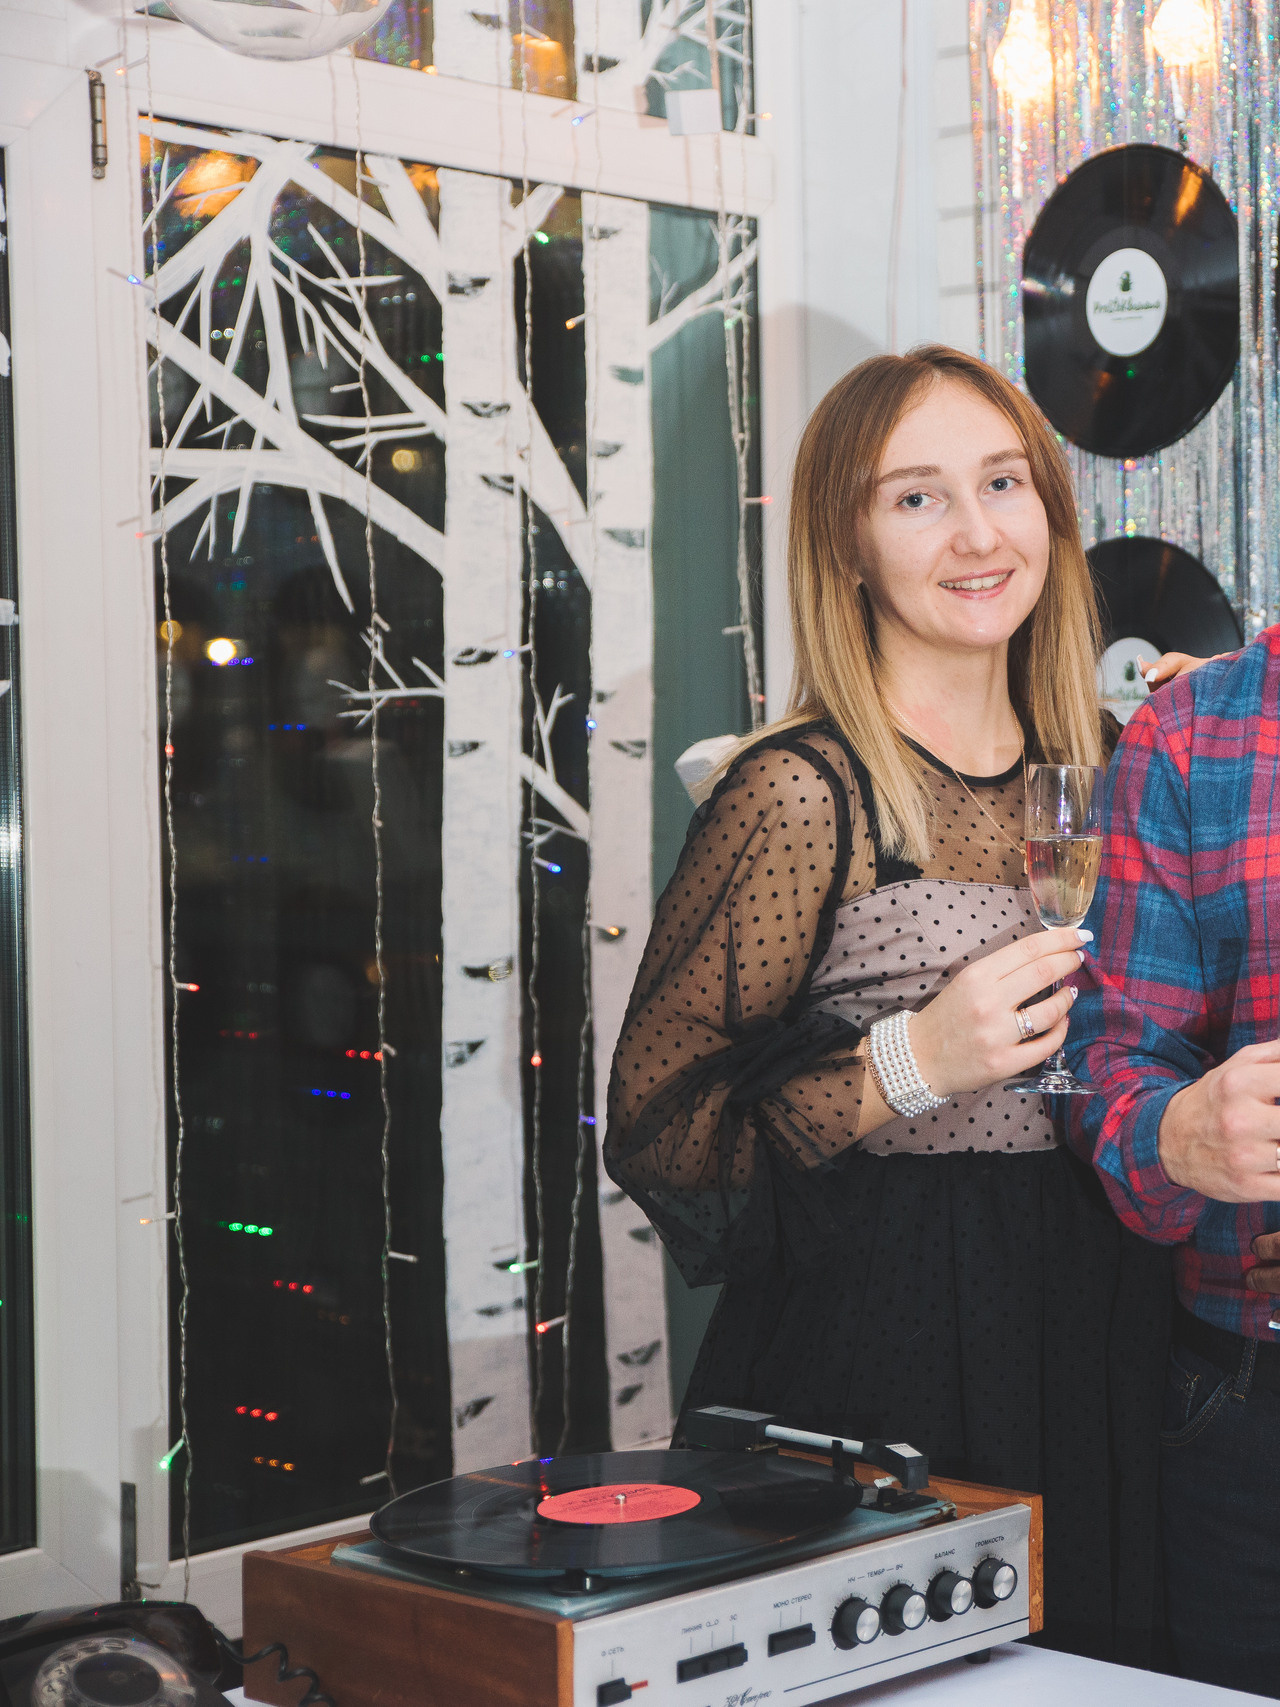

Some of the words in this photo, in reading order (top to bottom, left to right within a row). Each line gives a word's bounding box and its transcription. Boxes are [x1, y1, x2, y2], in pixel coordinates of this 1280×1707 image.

[974, 1535, 1005, 1548] ГРОМКОСТЬ
[934, 1548, 956, 1560] БАЛАНС
[867, 1568, 886, 1578] ТЕМБР
[773, 1599, 790, 1609] МОНО
[791, 1593, 813, 1604] СТЕРЕО
